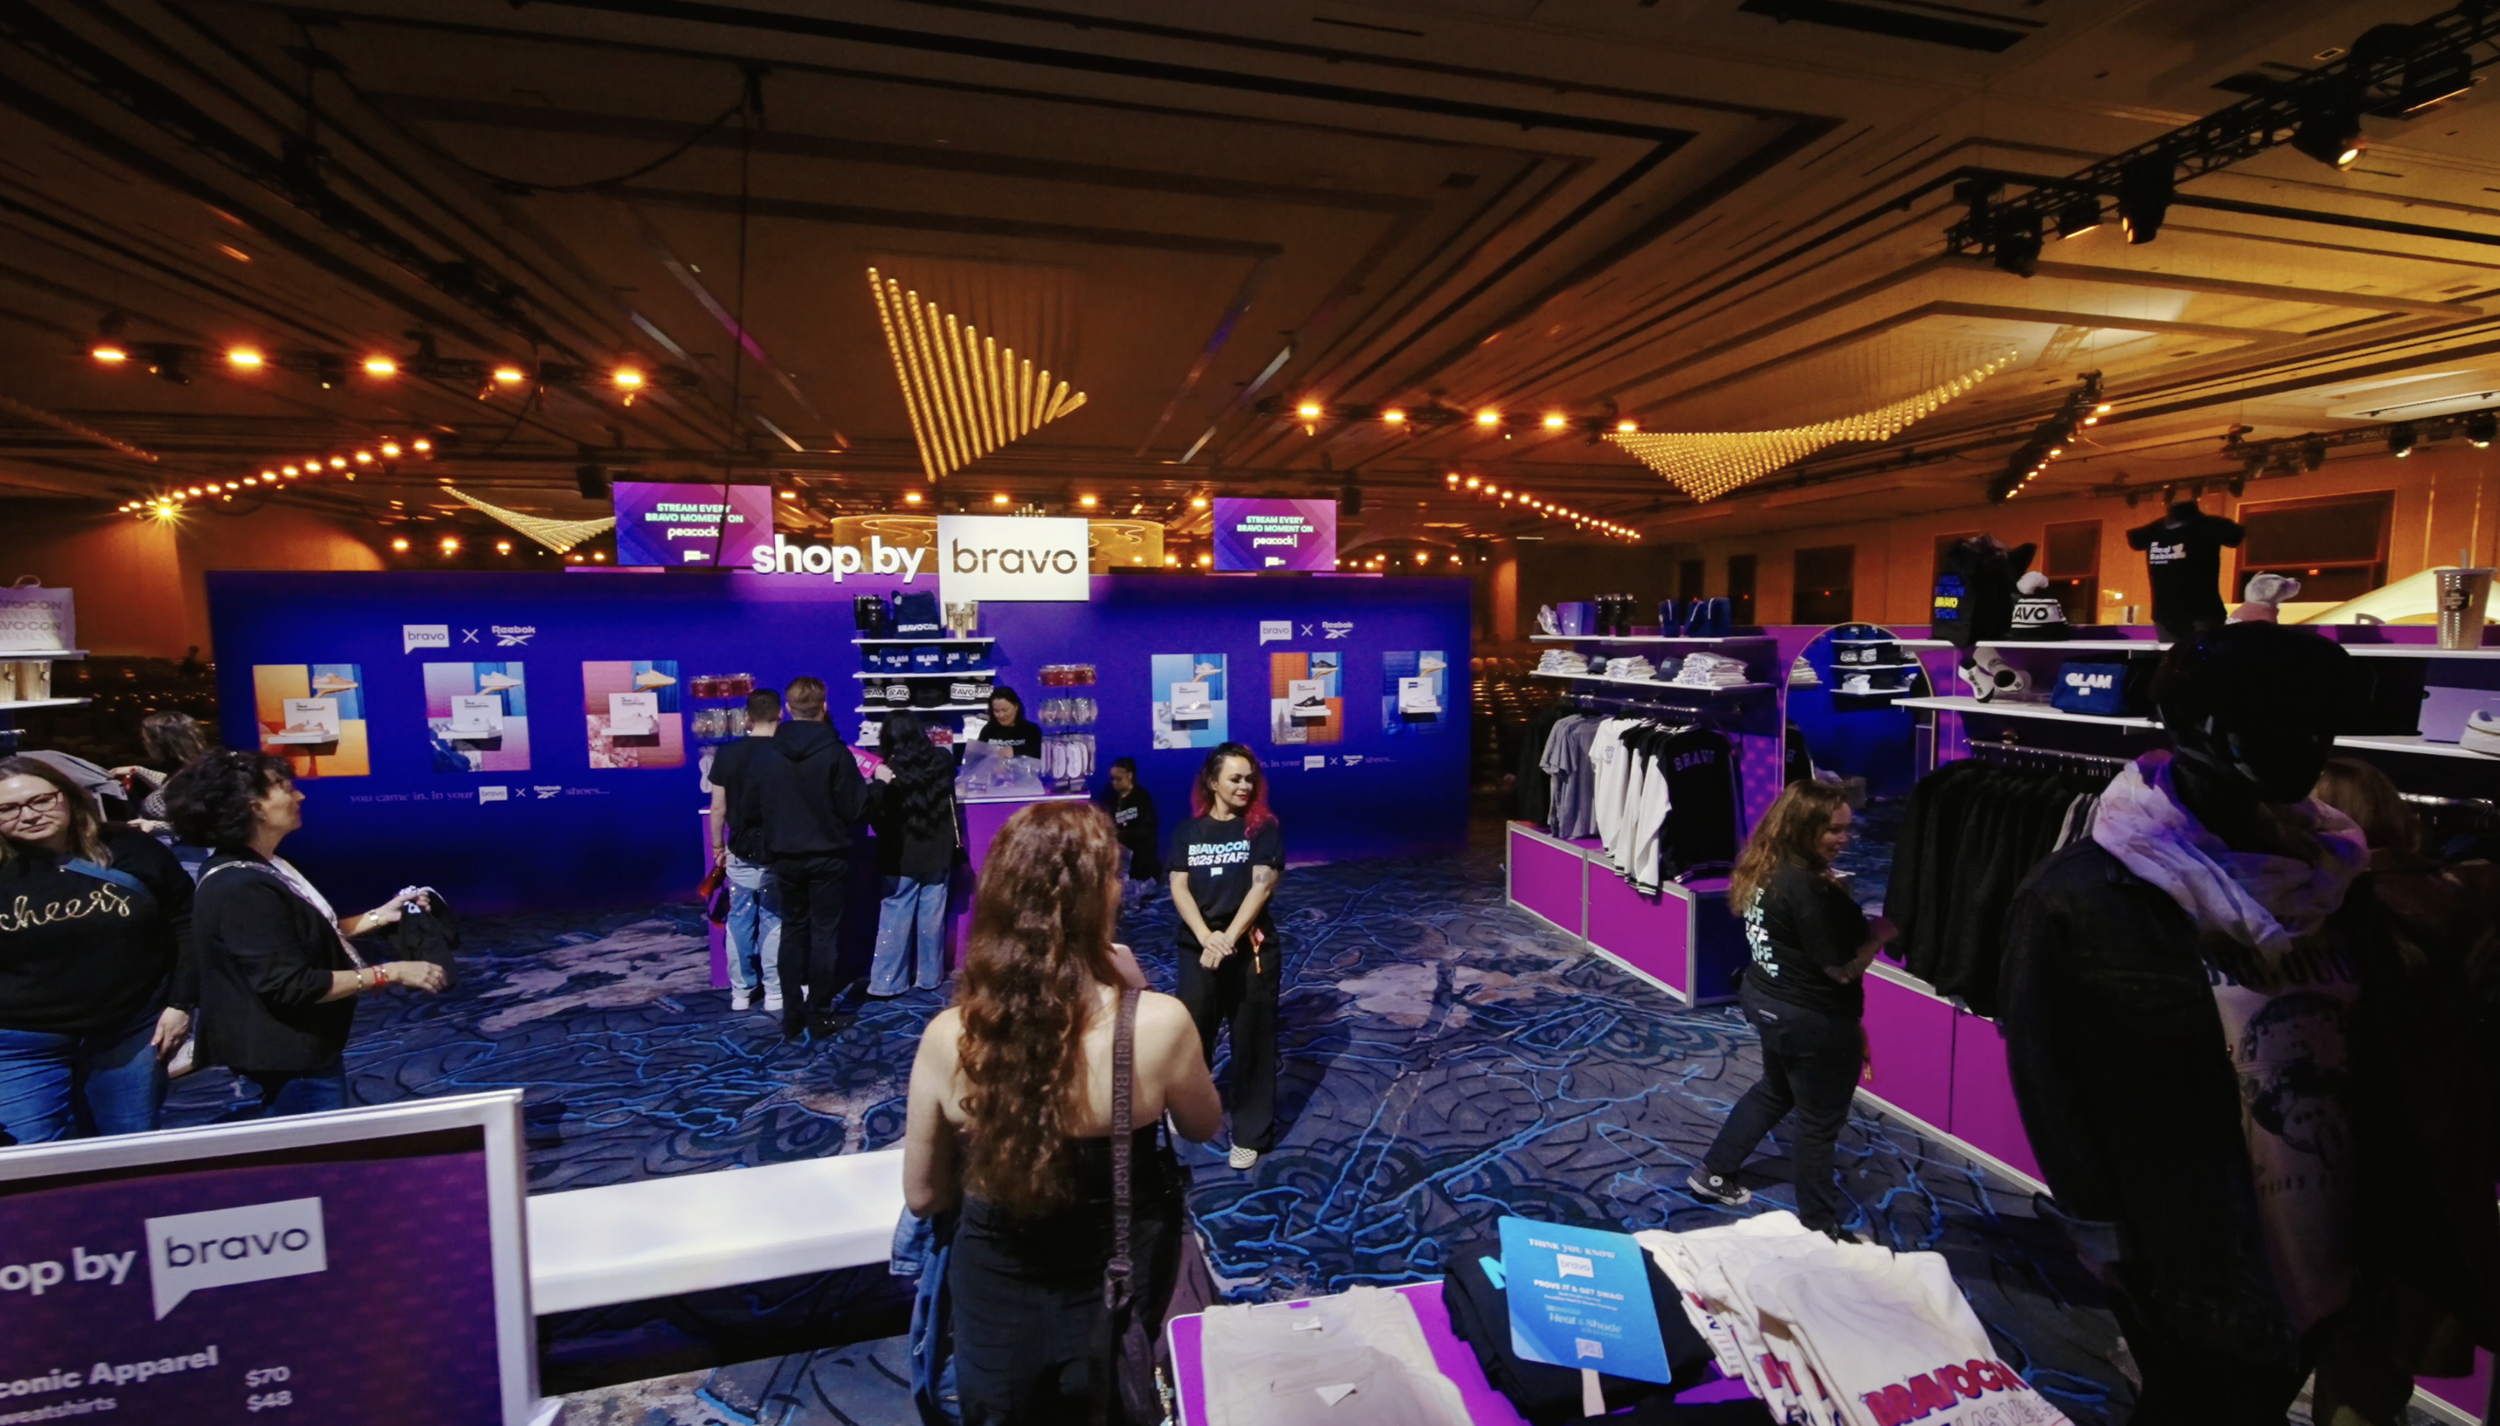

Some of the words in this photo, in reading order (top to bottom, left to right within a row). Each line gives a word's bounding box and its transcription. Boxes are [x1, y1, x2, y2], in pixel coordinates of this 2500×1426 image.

[657, 503, 698, 512] STREAM
[645, 513, 679, 522] BRAVO
[727, 514, 744, 523] ON
[1279, 516, 1305, 524] EVERY
[667, 526, 720, 540] peacock
[1237, 524, 1263, 532] BRAVO
[1301, 525, 1314, 533] ON
[1253, 535, 1294, 548] peacock
[752, 534, 862, 583] shop
[871, 535, 926, 584] by
[952, 537, 1078, 575] bravo
[408, 631, 445, 641] bravo
[491, 626, 536, 635] Reebok
[1263, 626, 1290, 634] bravo
[1322, 621, 1354, 629] Reebok
[2066, 672, 2113, 689] GLAM
[1673, 750, 1715, 771] BRAVO
[446, 791, 475, 802] your
[481, 789, 505, 797] bravo
[1213, 852, 1250, 864] STAFF
[0, 882, 130, 931] cheers
[1113, 1073, 1130, 1135] BAGGU
[1113, 1145, 1129, 1207] BAGGU
[71, 1246, 138, 1285] by
[165, 1228, 311, 1269] bravo
[1560, 1260, 1591, 1273] bravo
[88, 1344, 219, 1386] Apparel
[245, 1366, 291, 1387] $70
[246, 1390, 294, 1412] $48
